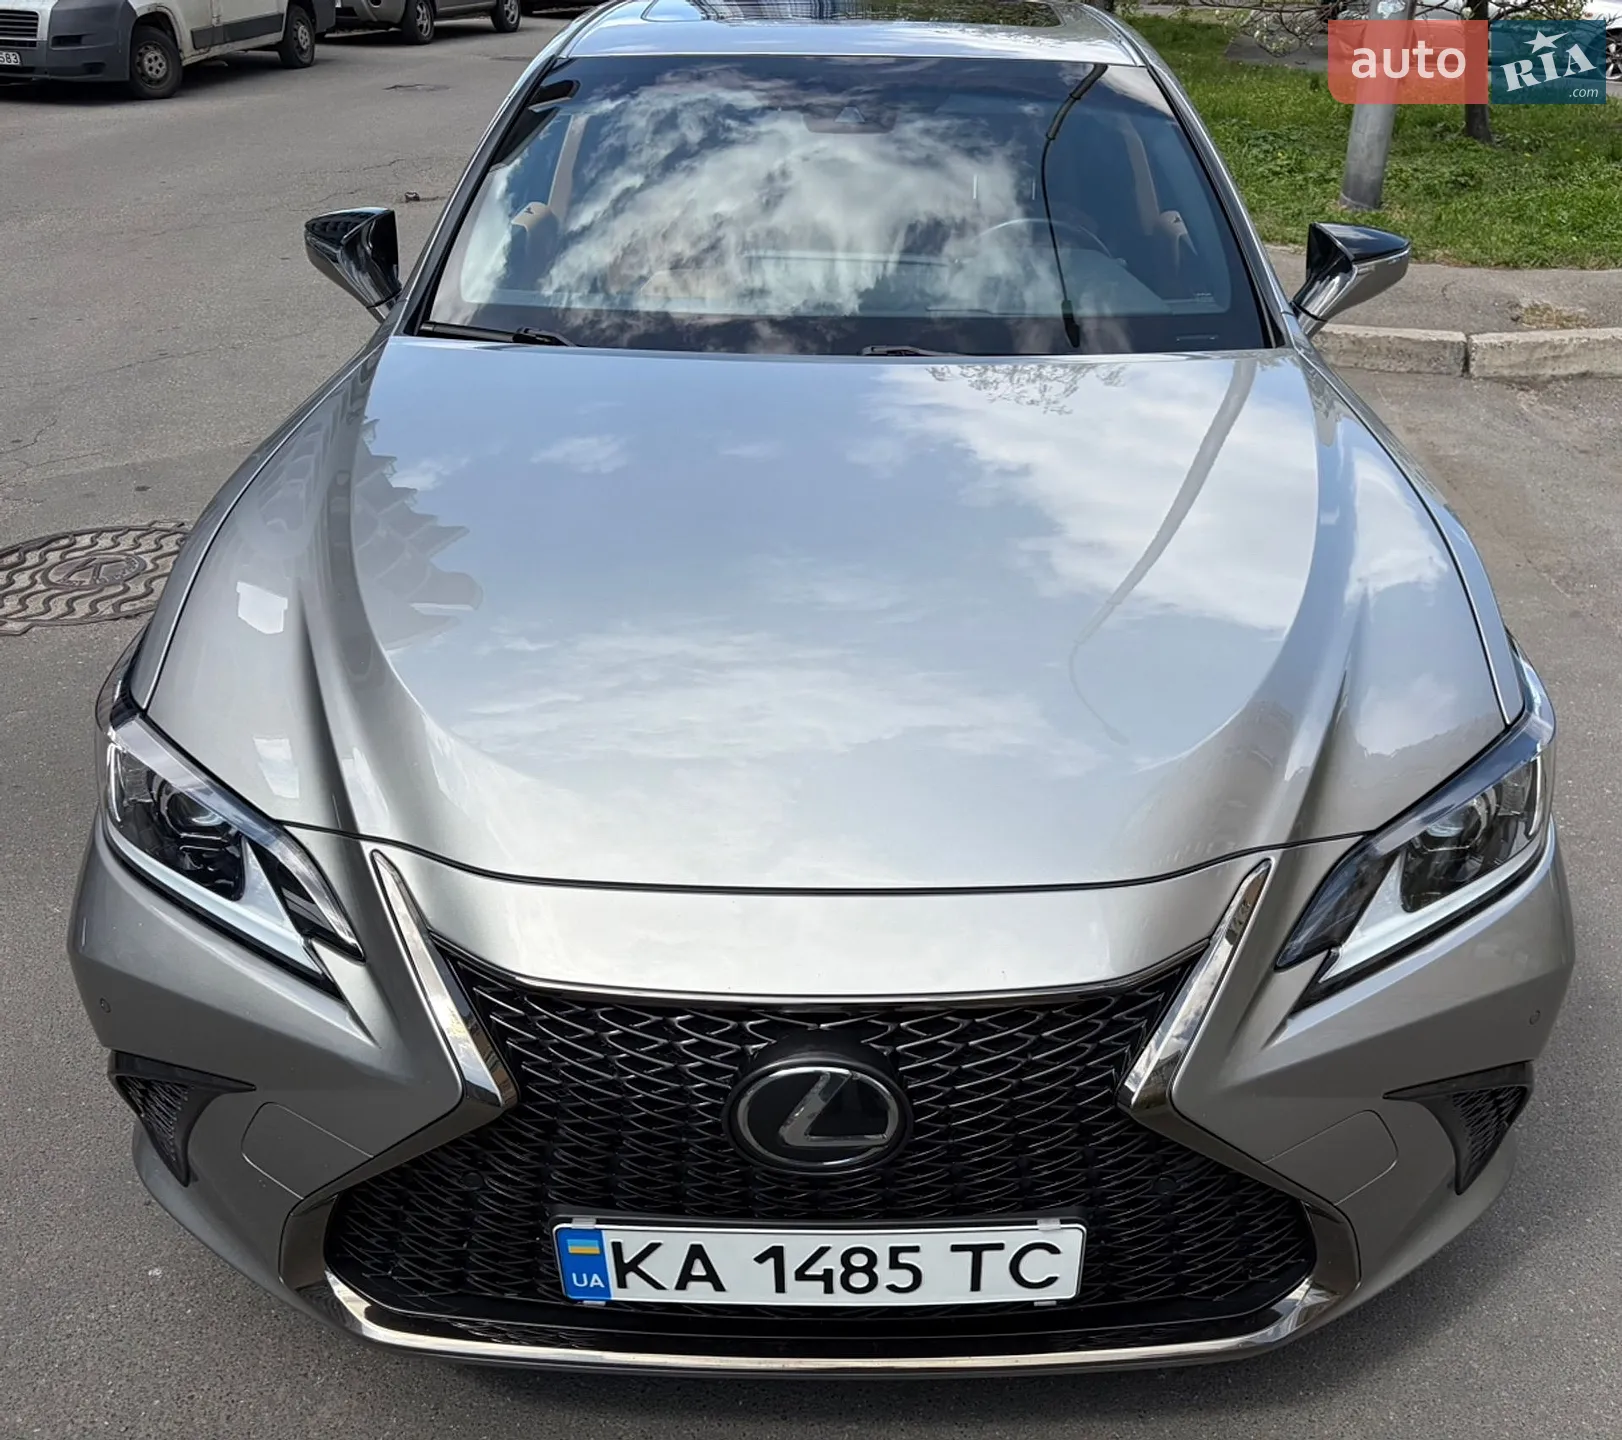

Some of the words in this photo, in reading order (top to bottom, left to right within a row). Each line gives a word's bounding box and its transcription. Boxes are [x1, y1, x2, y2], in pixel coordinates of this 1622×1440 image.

[571, 1272, 605, 1288] UA
[610, 1241, 727, 1292] KA
[753, 1245, 923, 1295] 1485
[950, 1242, 1062, 1290] TC
